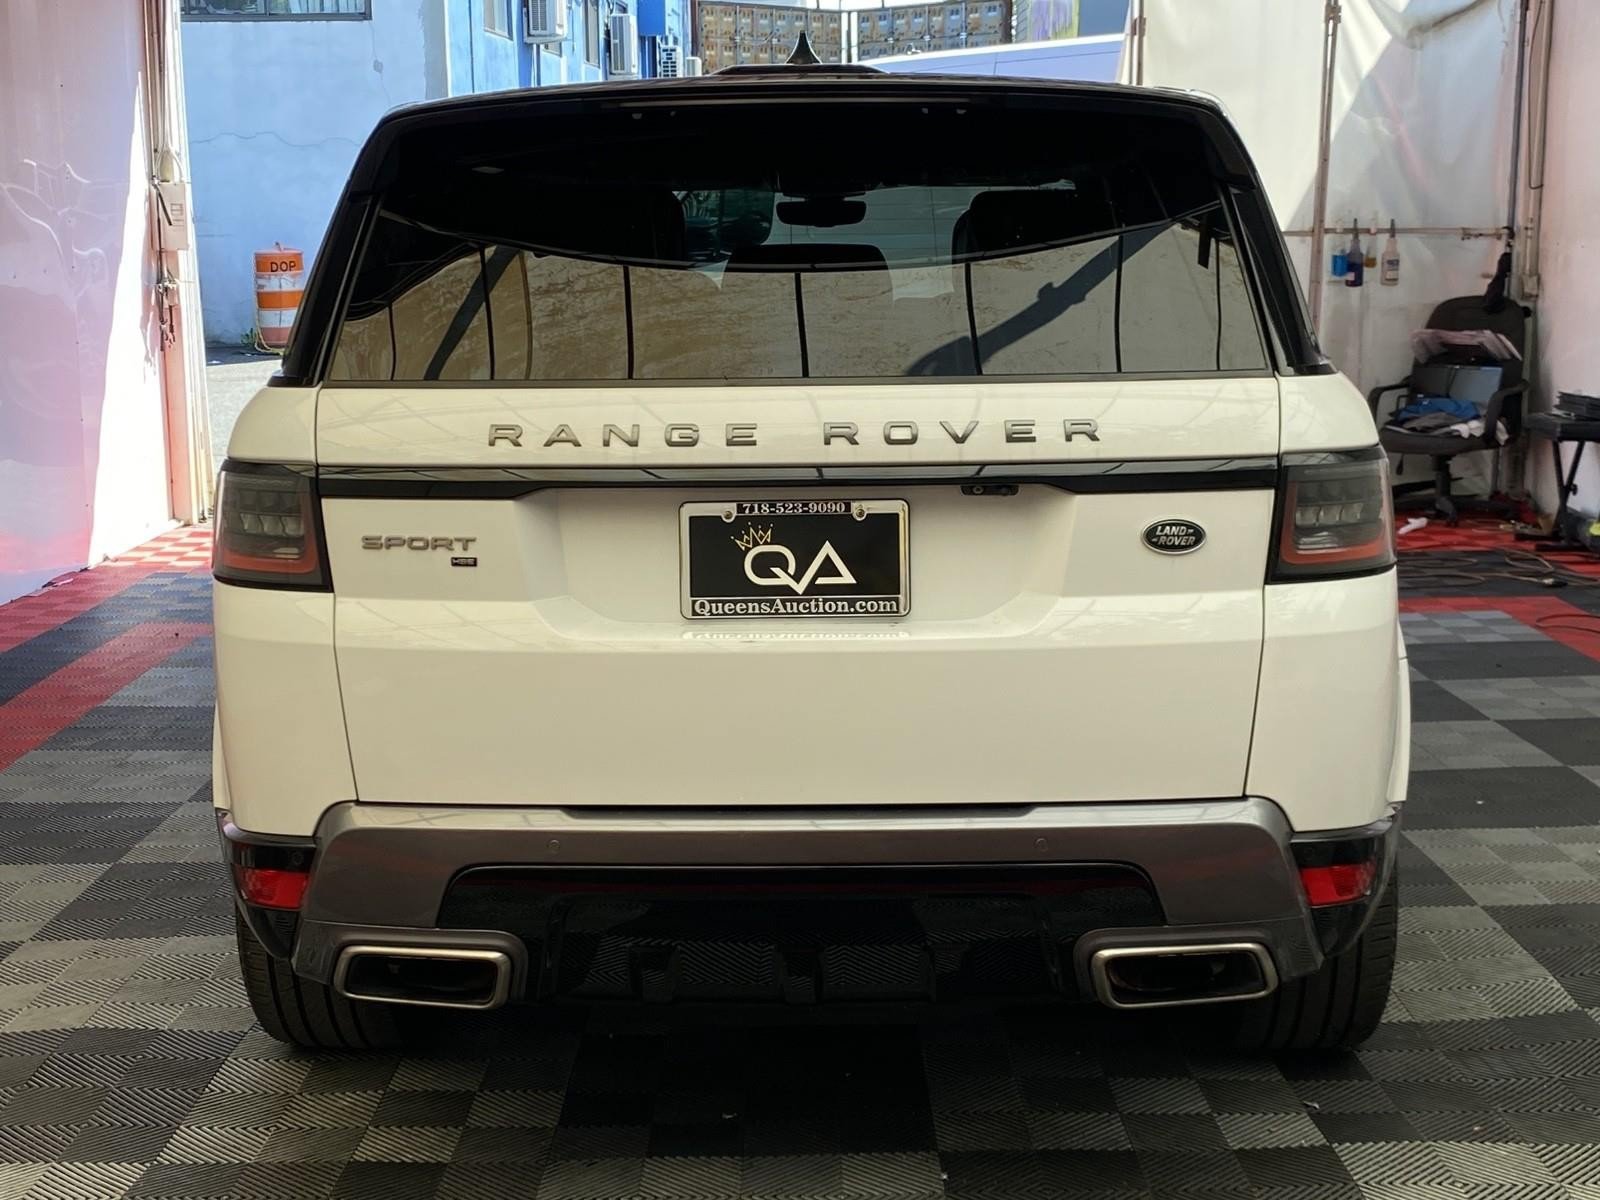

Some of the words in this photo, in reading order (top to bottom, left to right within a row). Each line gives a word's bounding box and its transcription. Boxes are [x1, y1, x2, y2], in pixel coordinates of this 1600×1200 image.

[270, 261, 296, 272] DOP
[488, 423, 758, 447] RANGE
[823, 418, 1101, 446] ROVER
[742, 501, 846, 514] 718-523-9090
[1156, 525, 1187, 535] LAND
[361, 535, 478, 551] SPORT
[1157, 536, 1196, 545] ROVER
[744, 540, 857, 595] QA
[694, 598, 898, 616] QueensAuction.com
